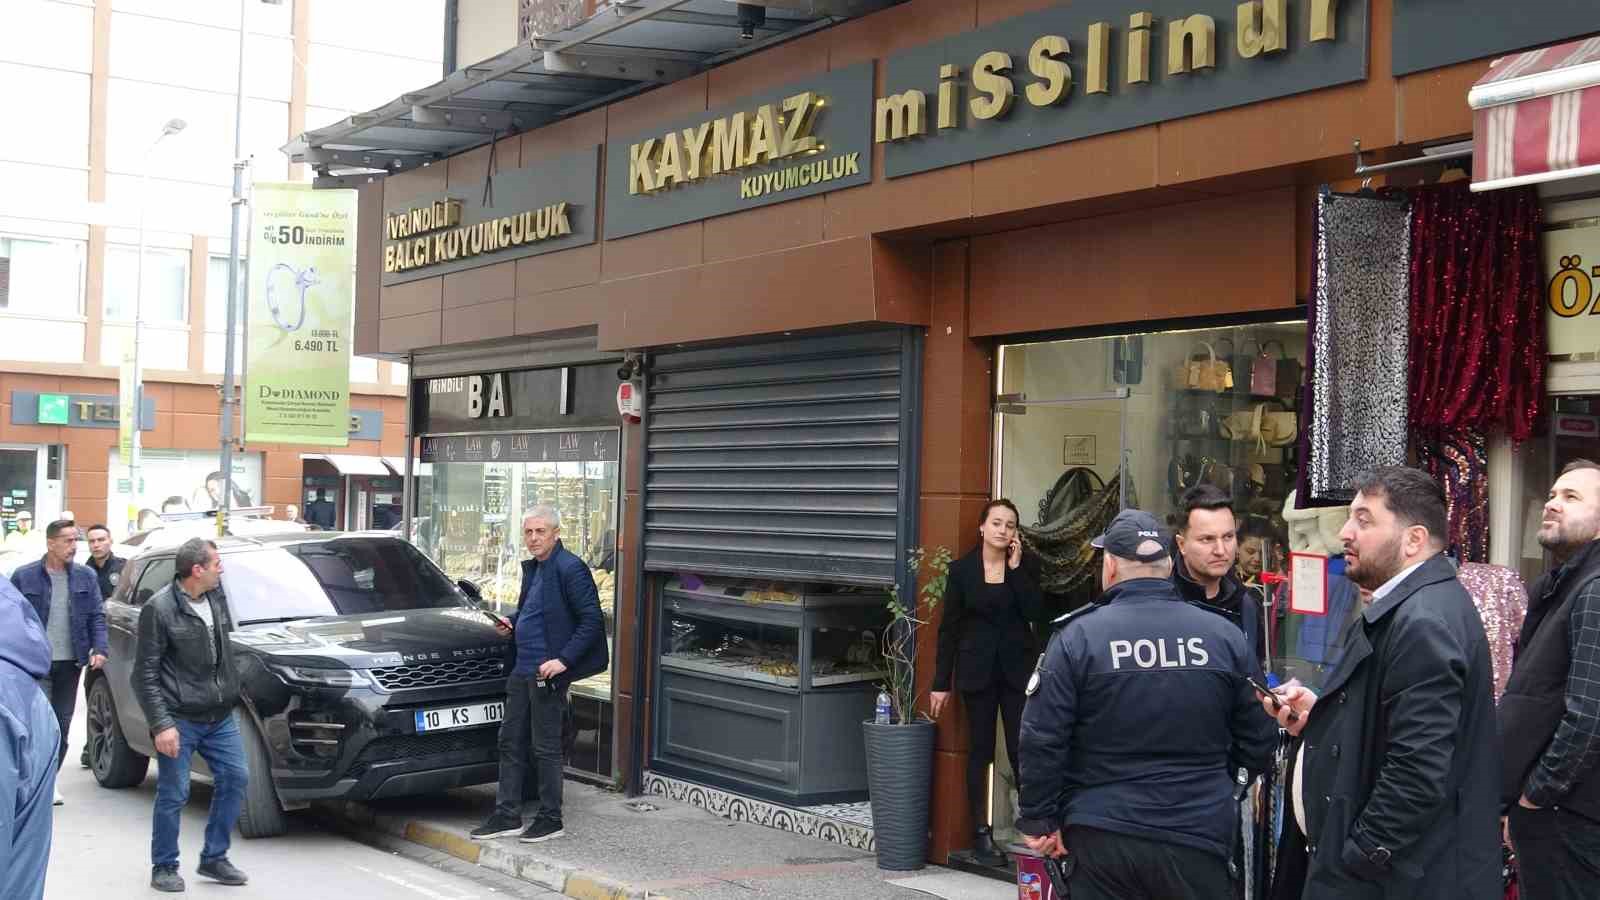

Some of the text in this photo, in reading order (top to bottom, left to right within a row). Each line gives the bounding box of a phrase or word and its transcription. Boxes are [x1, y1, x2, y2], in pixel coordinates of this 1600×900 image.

[629, 91, 817, 196] KAYMAZ
[740, 151, 861, 200] KUYUMCULUK
[384, 201, 571, 273] BALCI KUYUMCULUK
[294, 340, 339, 352] 6.490 TL
[511, 433, 529, 449] LAW
[559, 432, 579, 449] LAW
[426, 711, 440, 728] 10
[452, 708, 469, 725] KS
